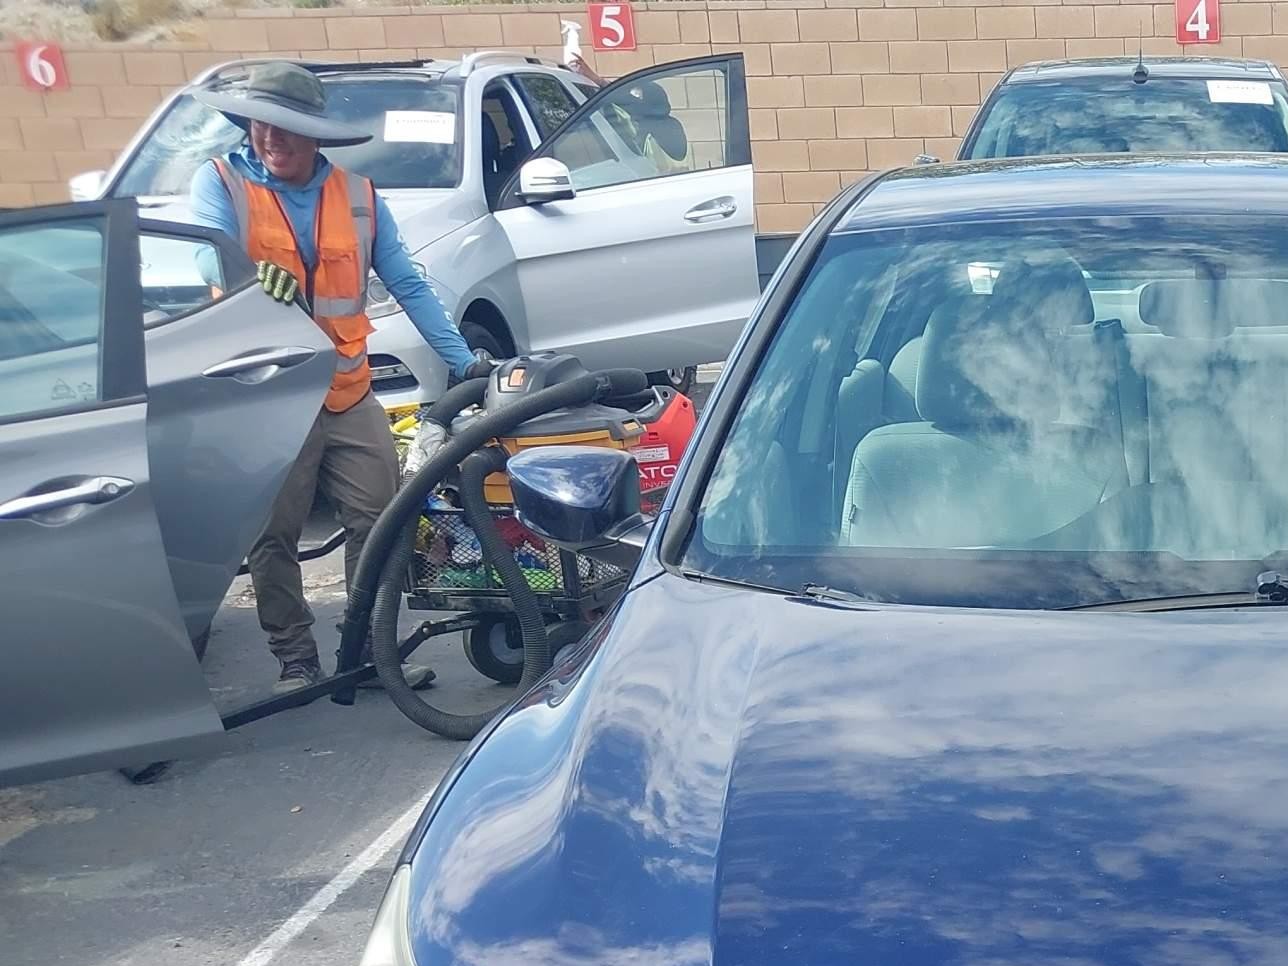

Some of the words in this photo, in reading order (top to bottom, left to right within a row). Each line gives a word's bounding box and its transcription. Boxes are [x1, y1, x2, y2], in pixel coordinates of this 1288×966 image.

[600, 5, 625, 48] 5
[1185, 0, 1210, 40] 4
[29, 46, 57, 88] 6
